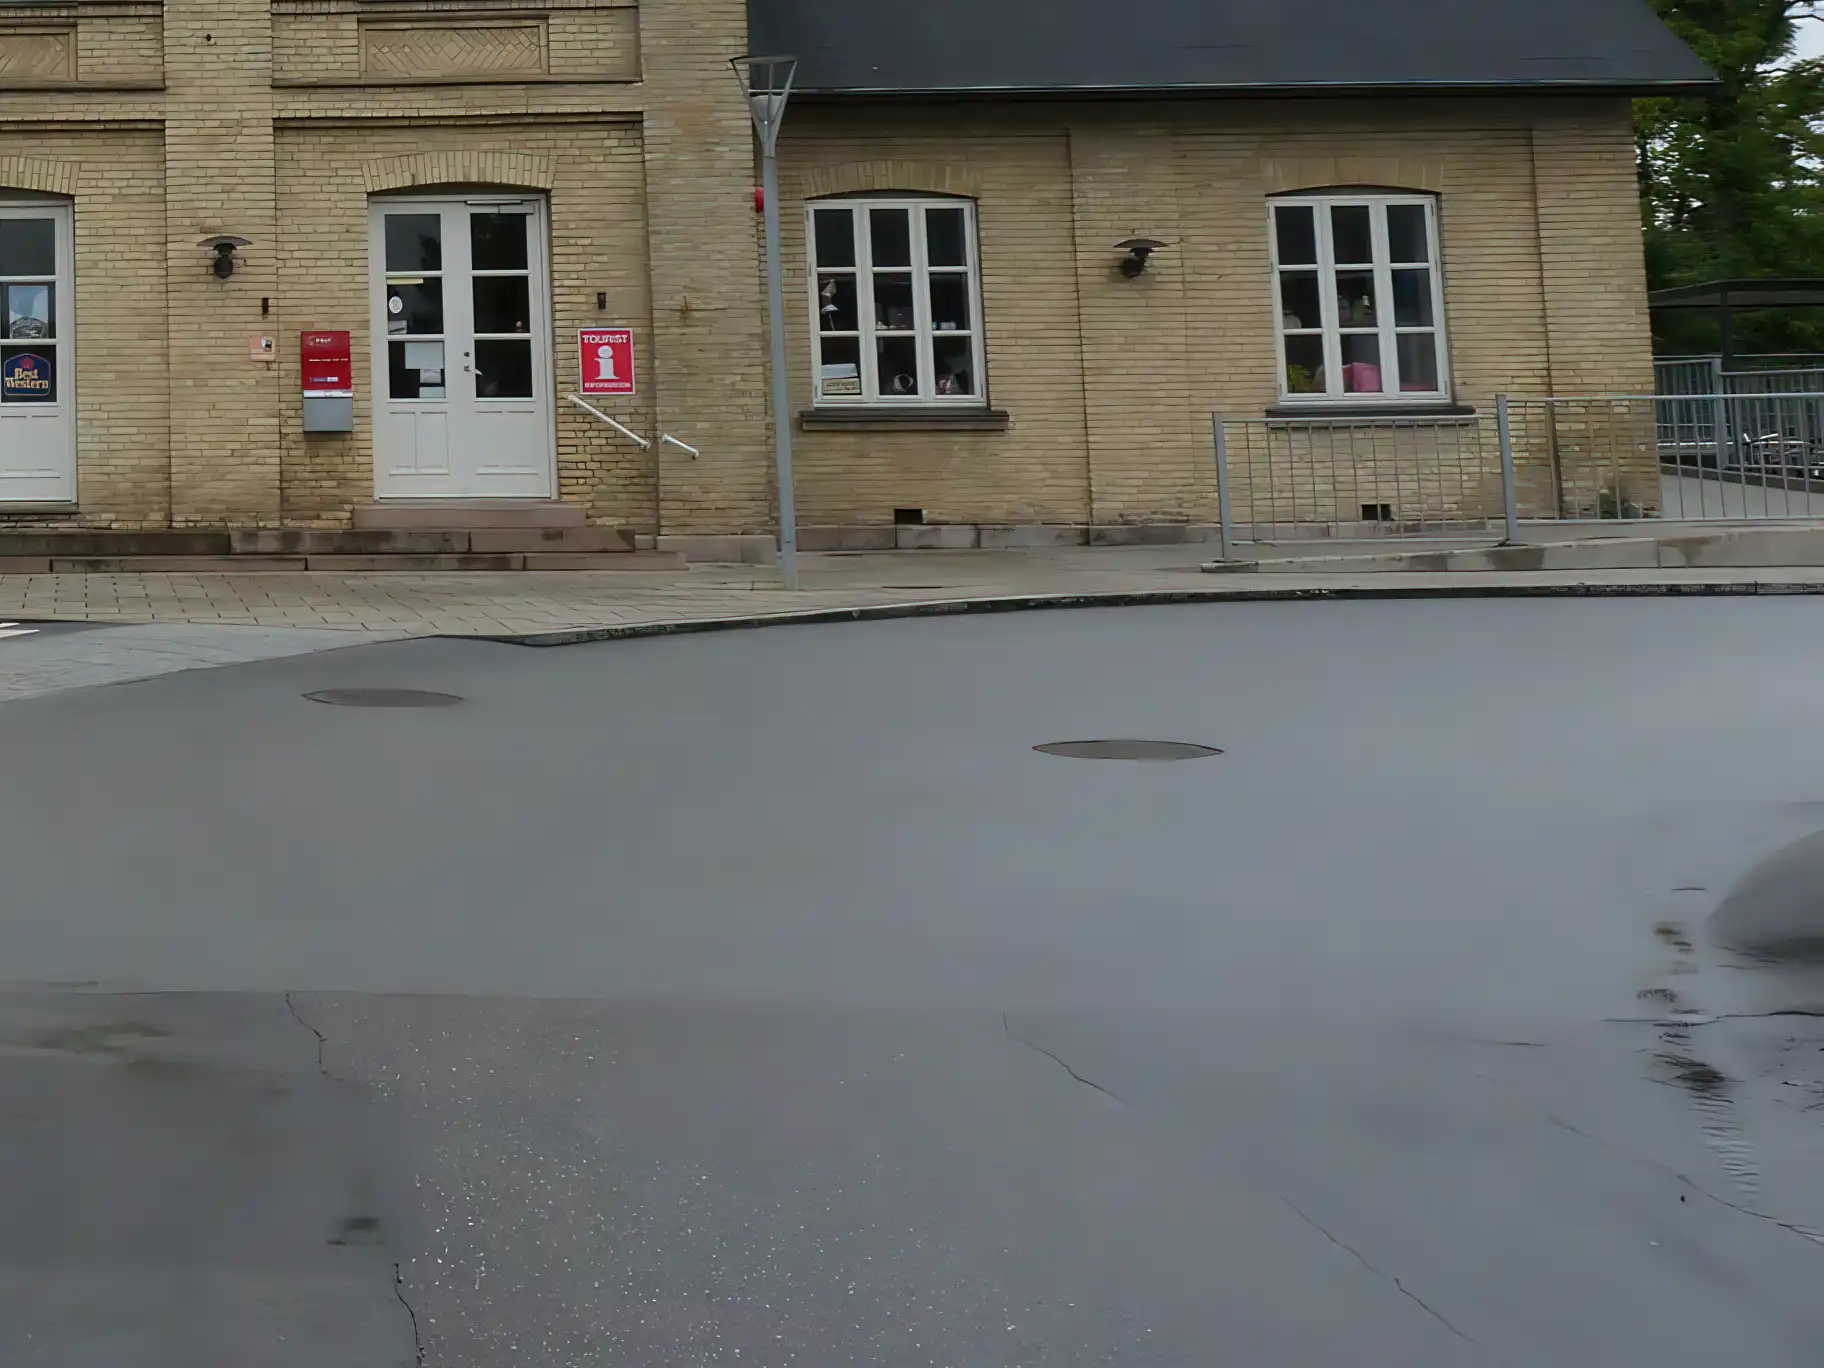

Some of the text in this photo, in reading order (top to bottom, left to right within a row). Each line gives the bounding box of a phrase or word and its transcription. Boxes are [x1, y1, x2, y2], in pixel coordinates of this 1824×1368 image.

[582, 334, 628, 344] TOURIST
[14, 367, 39, 380] Best
[5, 377, 49, 389] Western
